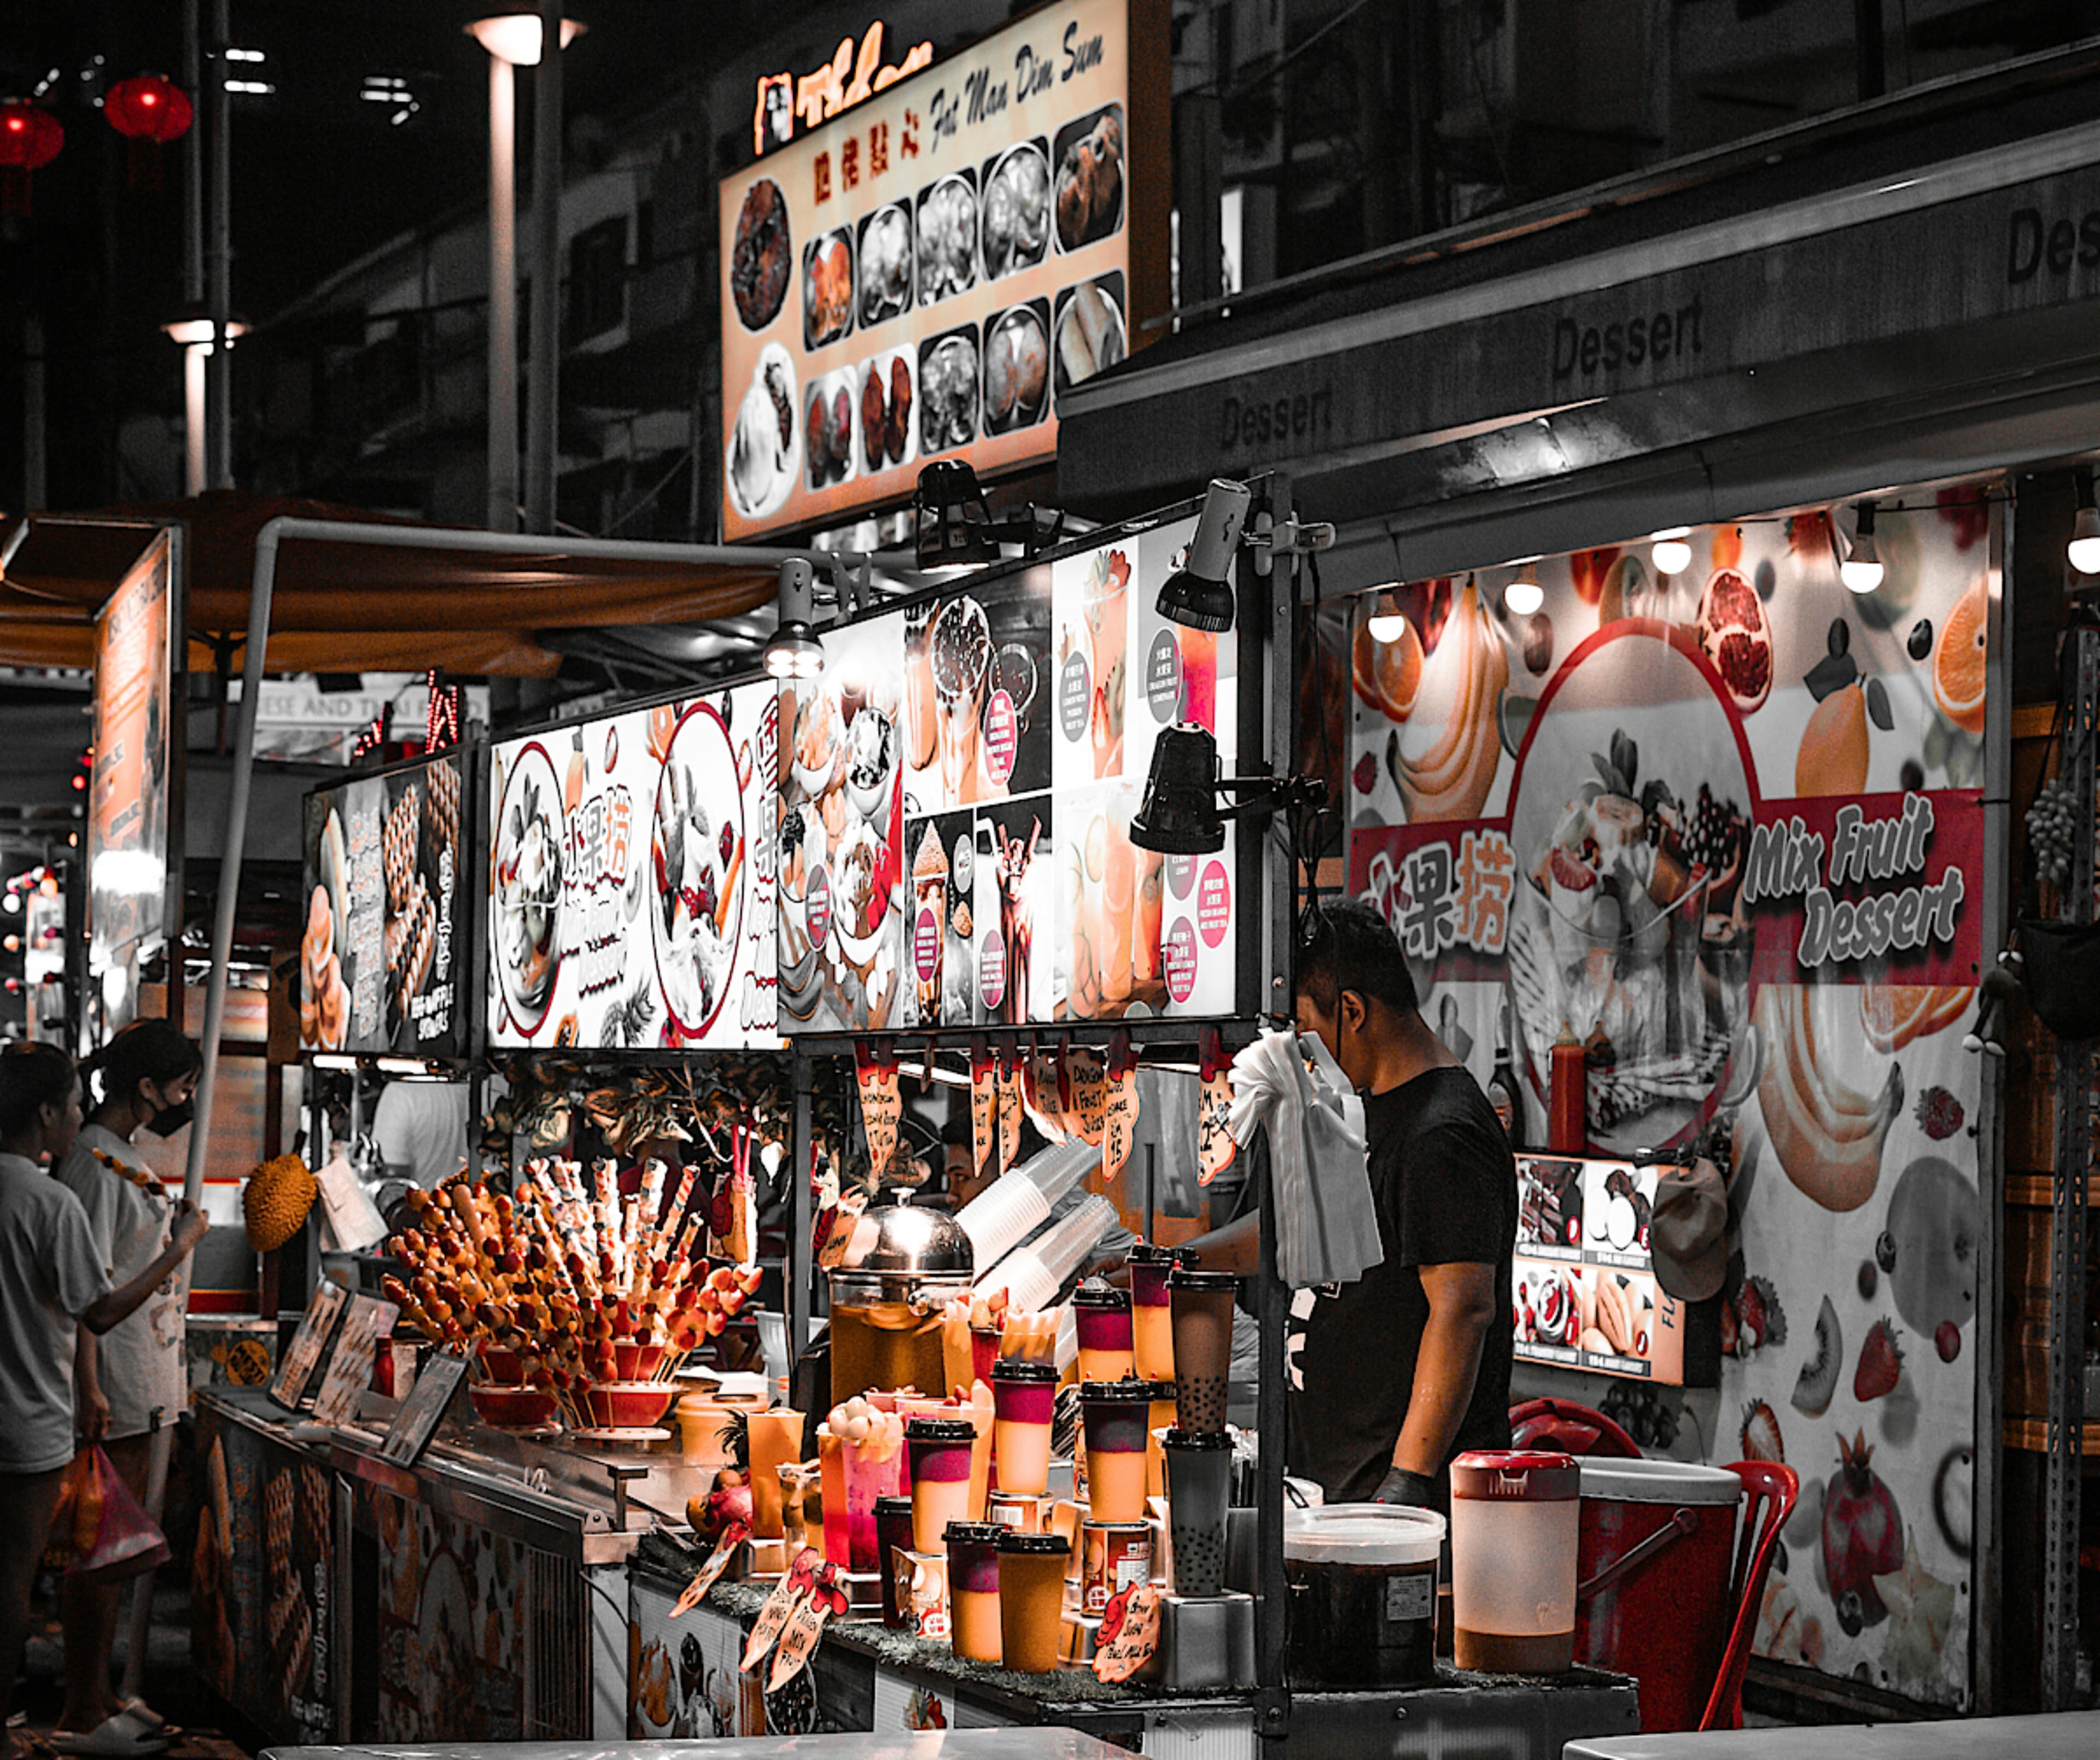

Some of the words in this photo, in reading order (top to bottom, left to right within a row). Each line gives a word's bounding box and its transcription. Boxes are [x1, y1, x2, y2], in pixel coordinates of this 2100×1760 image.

[964, 68, 1008, 125] Man
[1014, 44, 1055, 105] Dim
[1061, 20, 1105, 83] Sum
[1553, 293, 1704, 382] Dessert
[1219, 383, 1333, 451] Dessert
[1746, 816, 1824, 904] Mix
[1830, 791, 1934, 888] Fruit
[1799, 867, 1963, 967] Dessert
